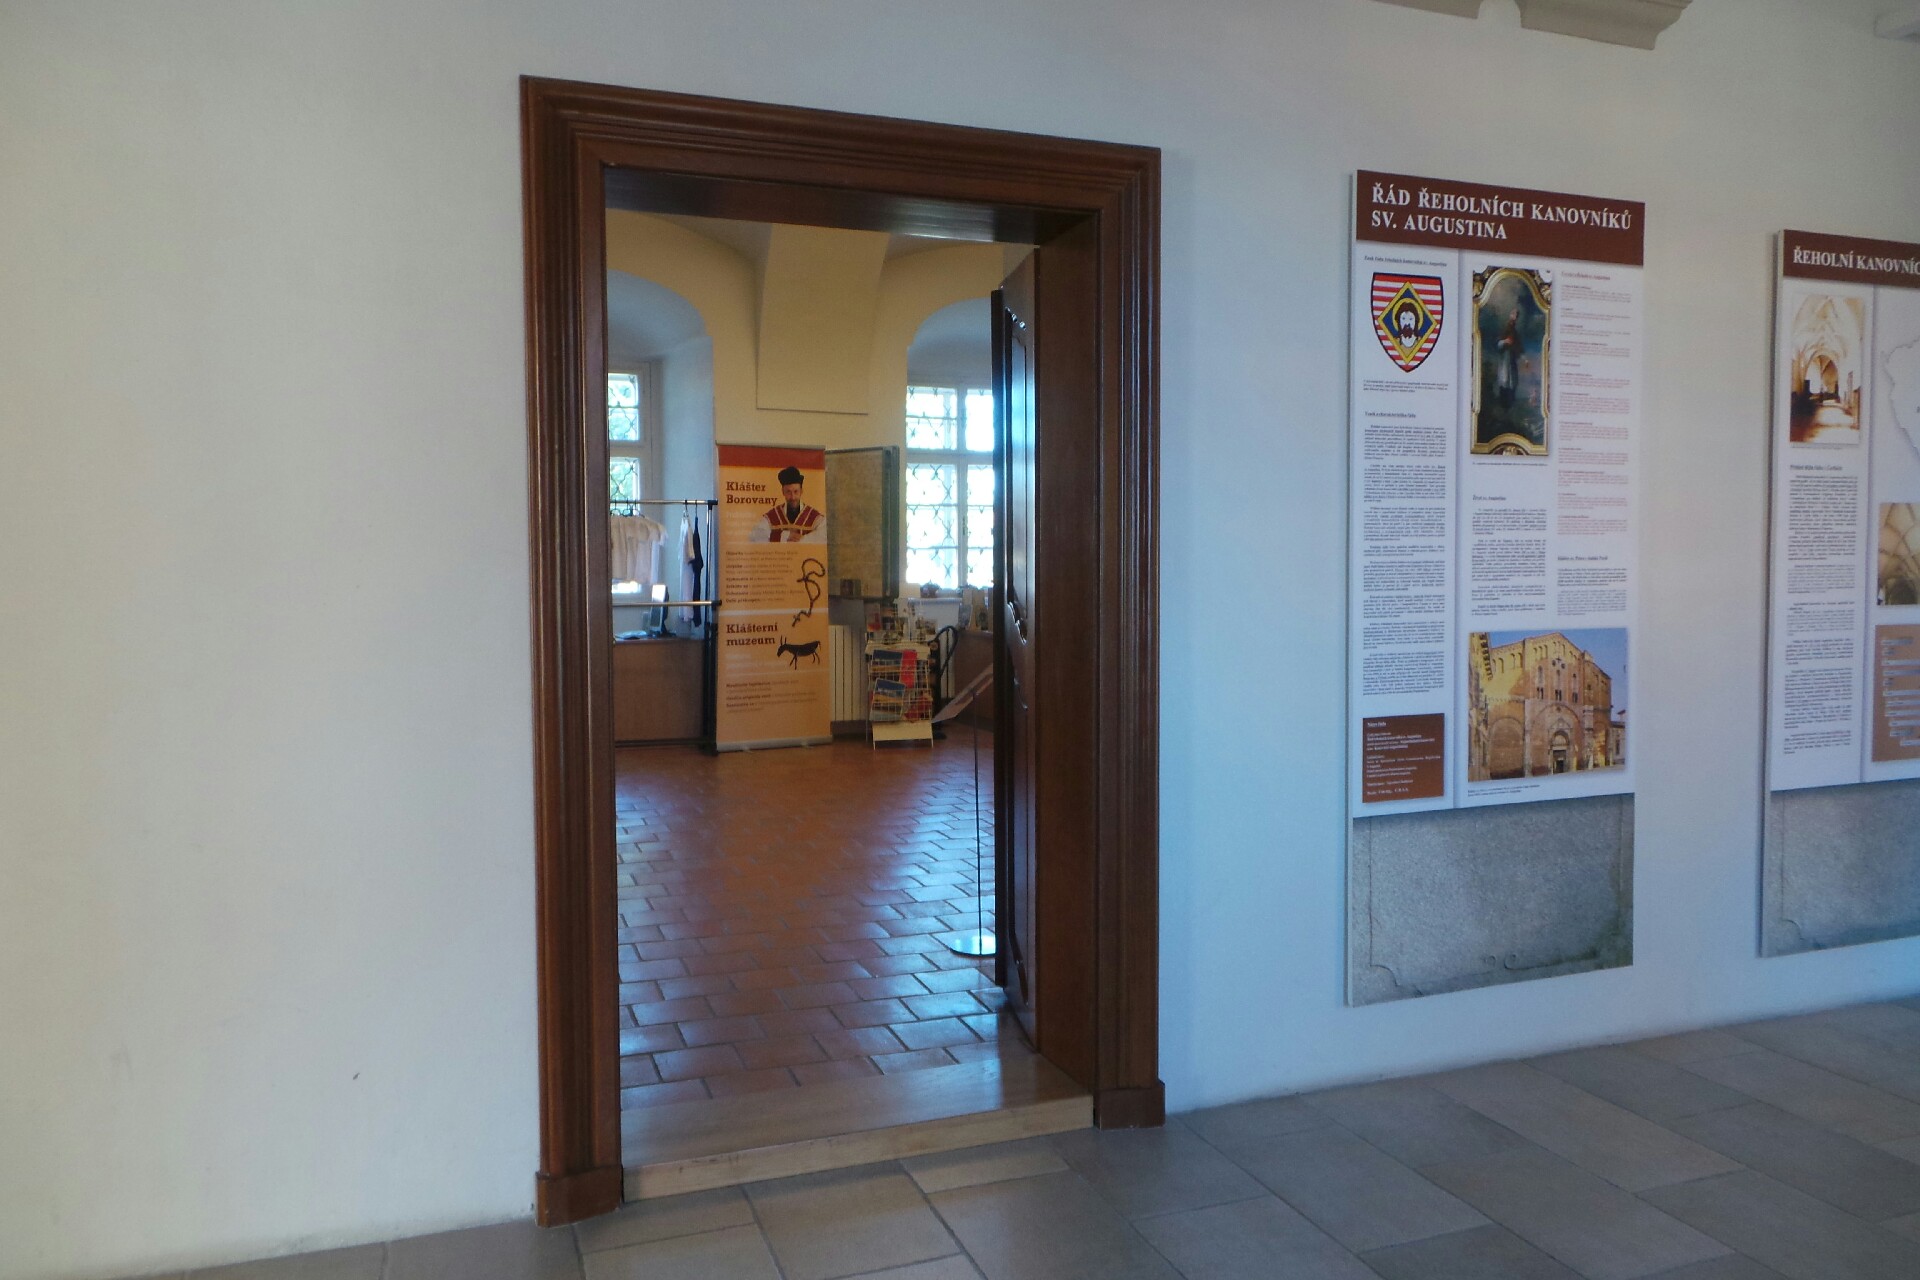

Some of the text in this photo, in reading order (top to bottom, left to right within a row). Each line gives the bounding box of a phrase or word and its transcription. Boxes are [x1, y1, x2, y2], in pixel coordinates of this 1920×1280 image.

[1372, 182, 1632, 230] ŘÁD ŘEHOLNÍCH KANOVNÍKŮ
[1371, 209, 1507, 240] SV. AUGUSTINA
[1793, 245, 1854, 269] ŘEHOLNÍ
[726, 481, 766, 492] Klášter
[726, 494, 778, 507] Borovany
[726, 622, 778, 634] Klášterní
[726, 637, 776, 647] muzeum
